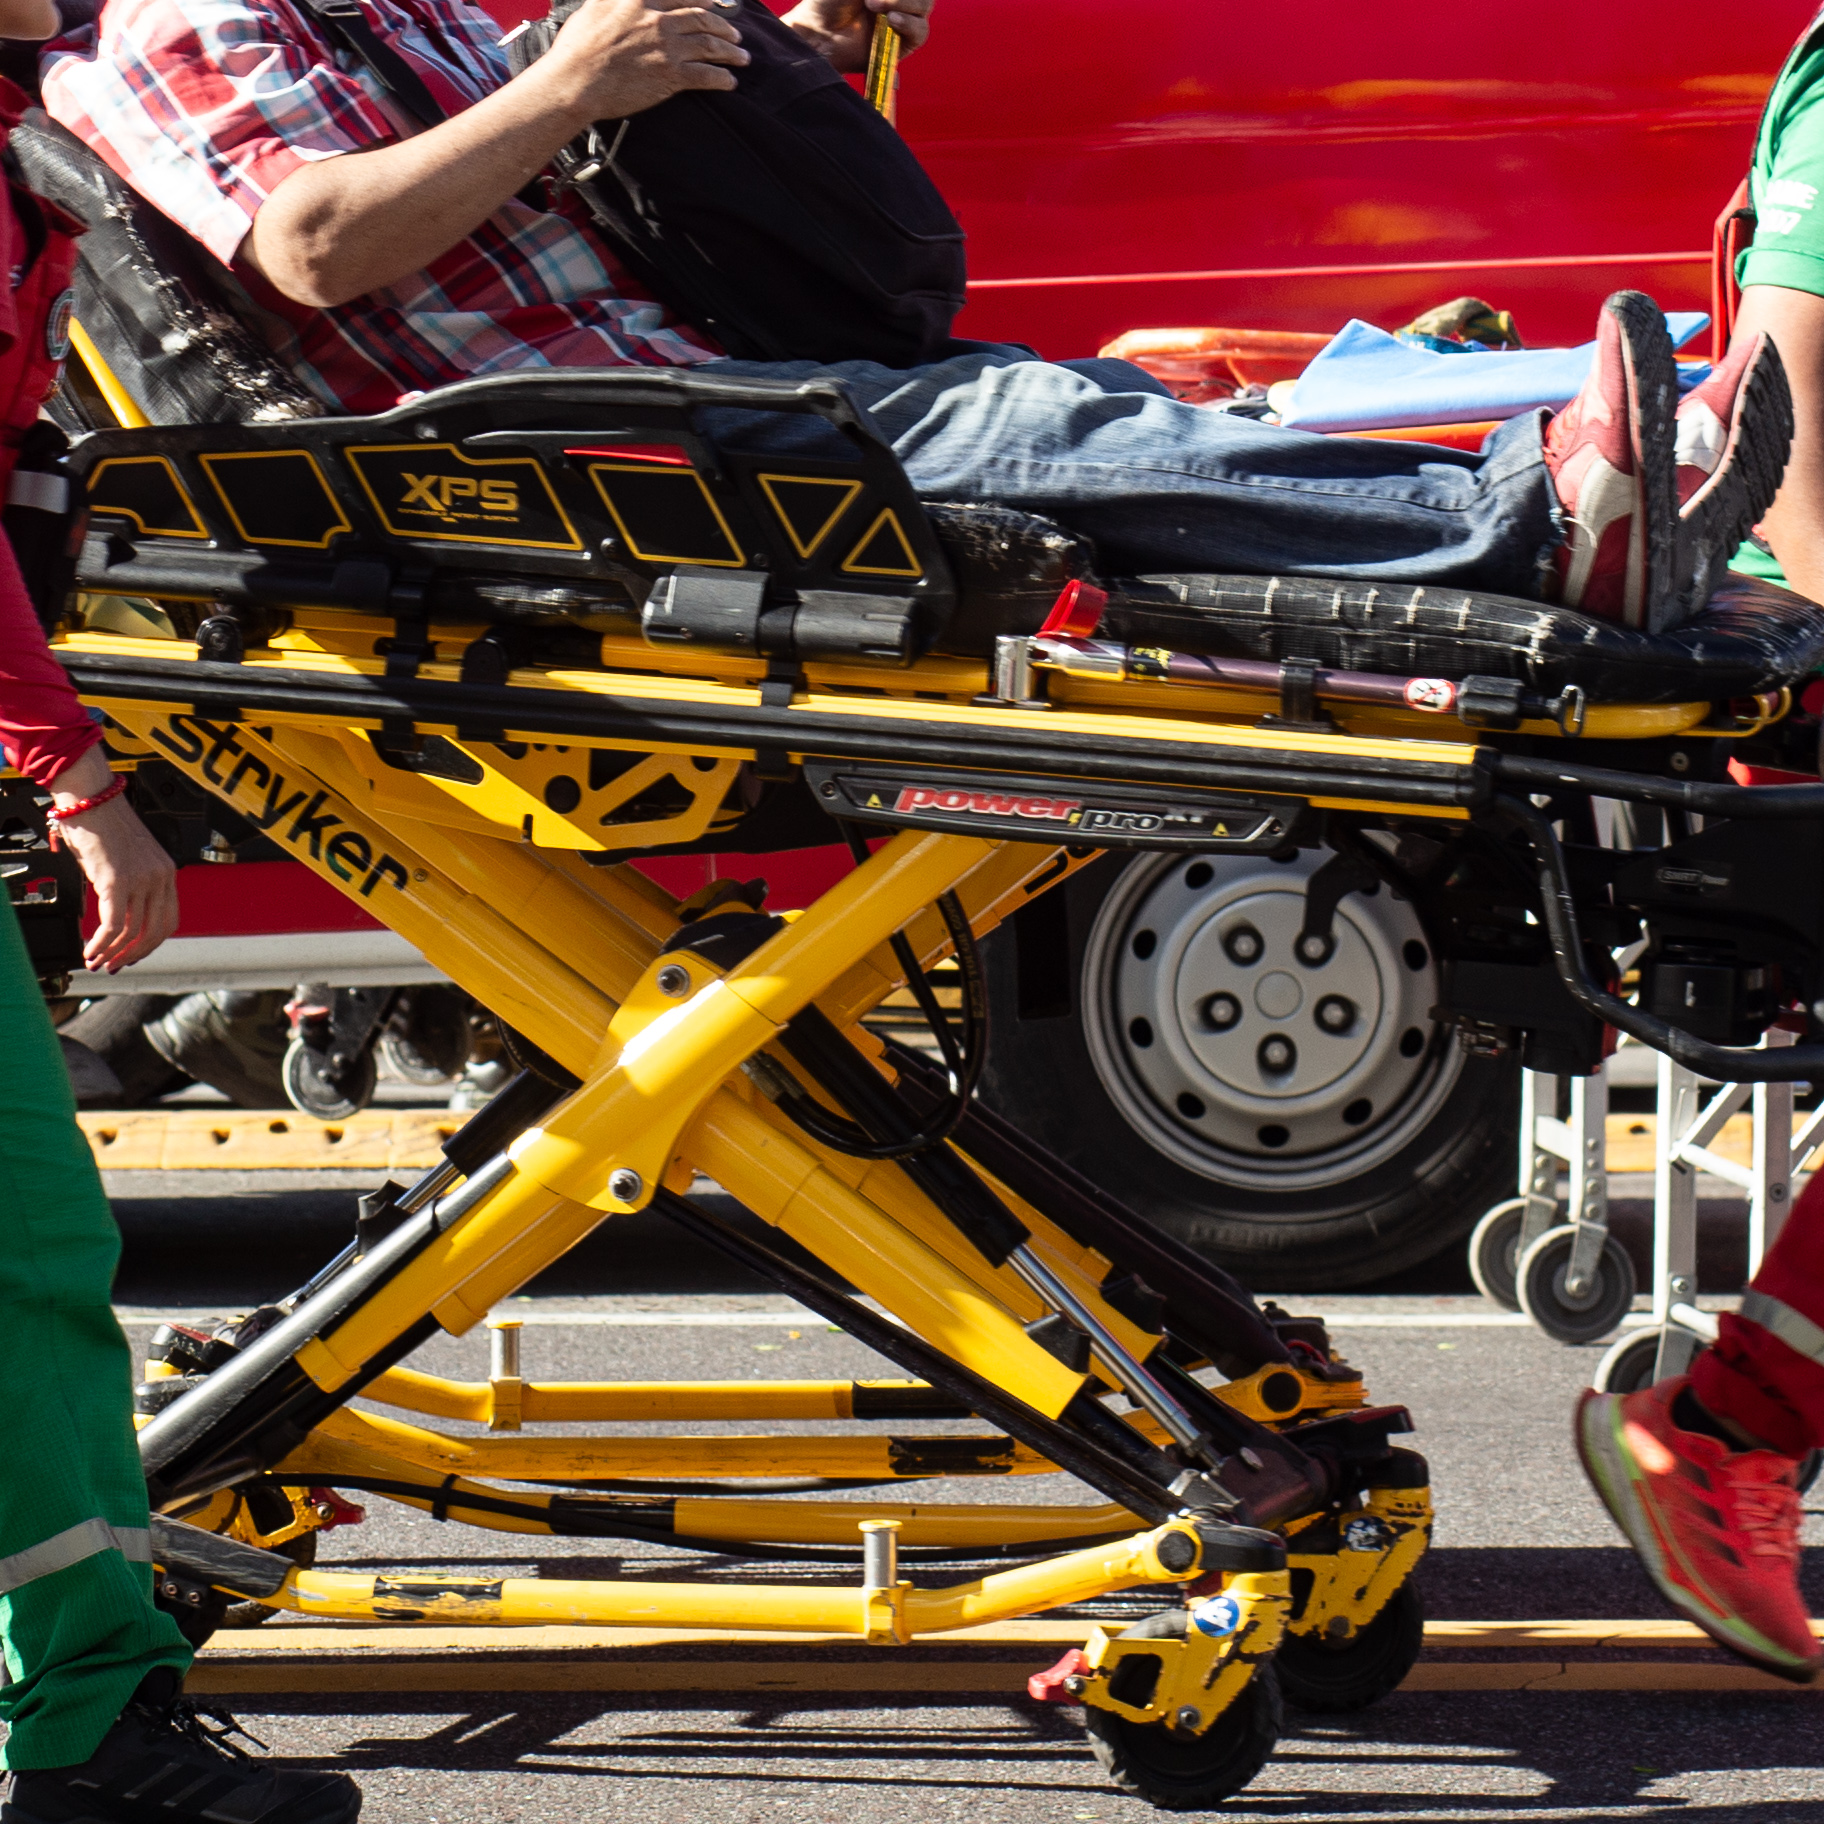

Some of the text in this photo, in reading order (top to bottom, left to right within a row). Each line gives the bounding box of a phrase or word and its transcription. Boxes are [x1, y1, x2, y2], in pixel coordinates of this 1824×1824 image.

[399, 472, 519, 511] XPS
[149, 714, 410, 898] stryker
[893, 786, 1083, 820] power
[1079, 808, 1166, 833] pro
